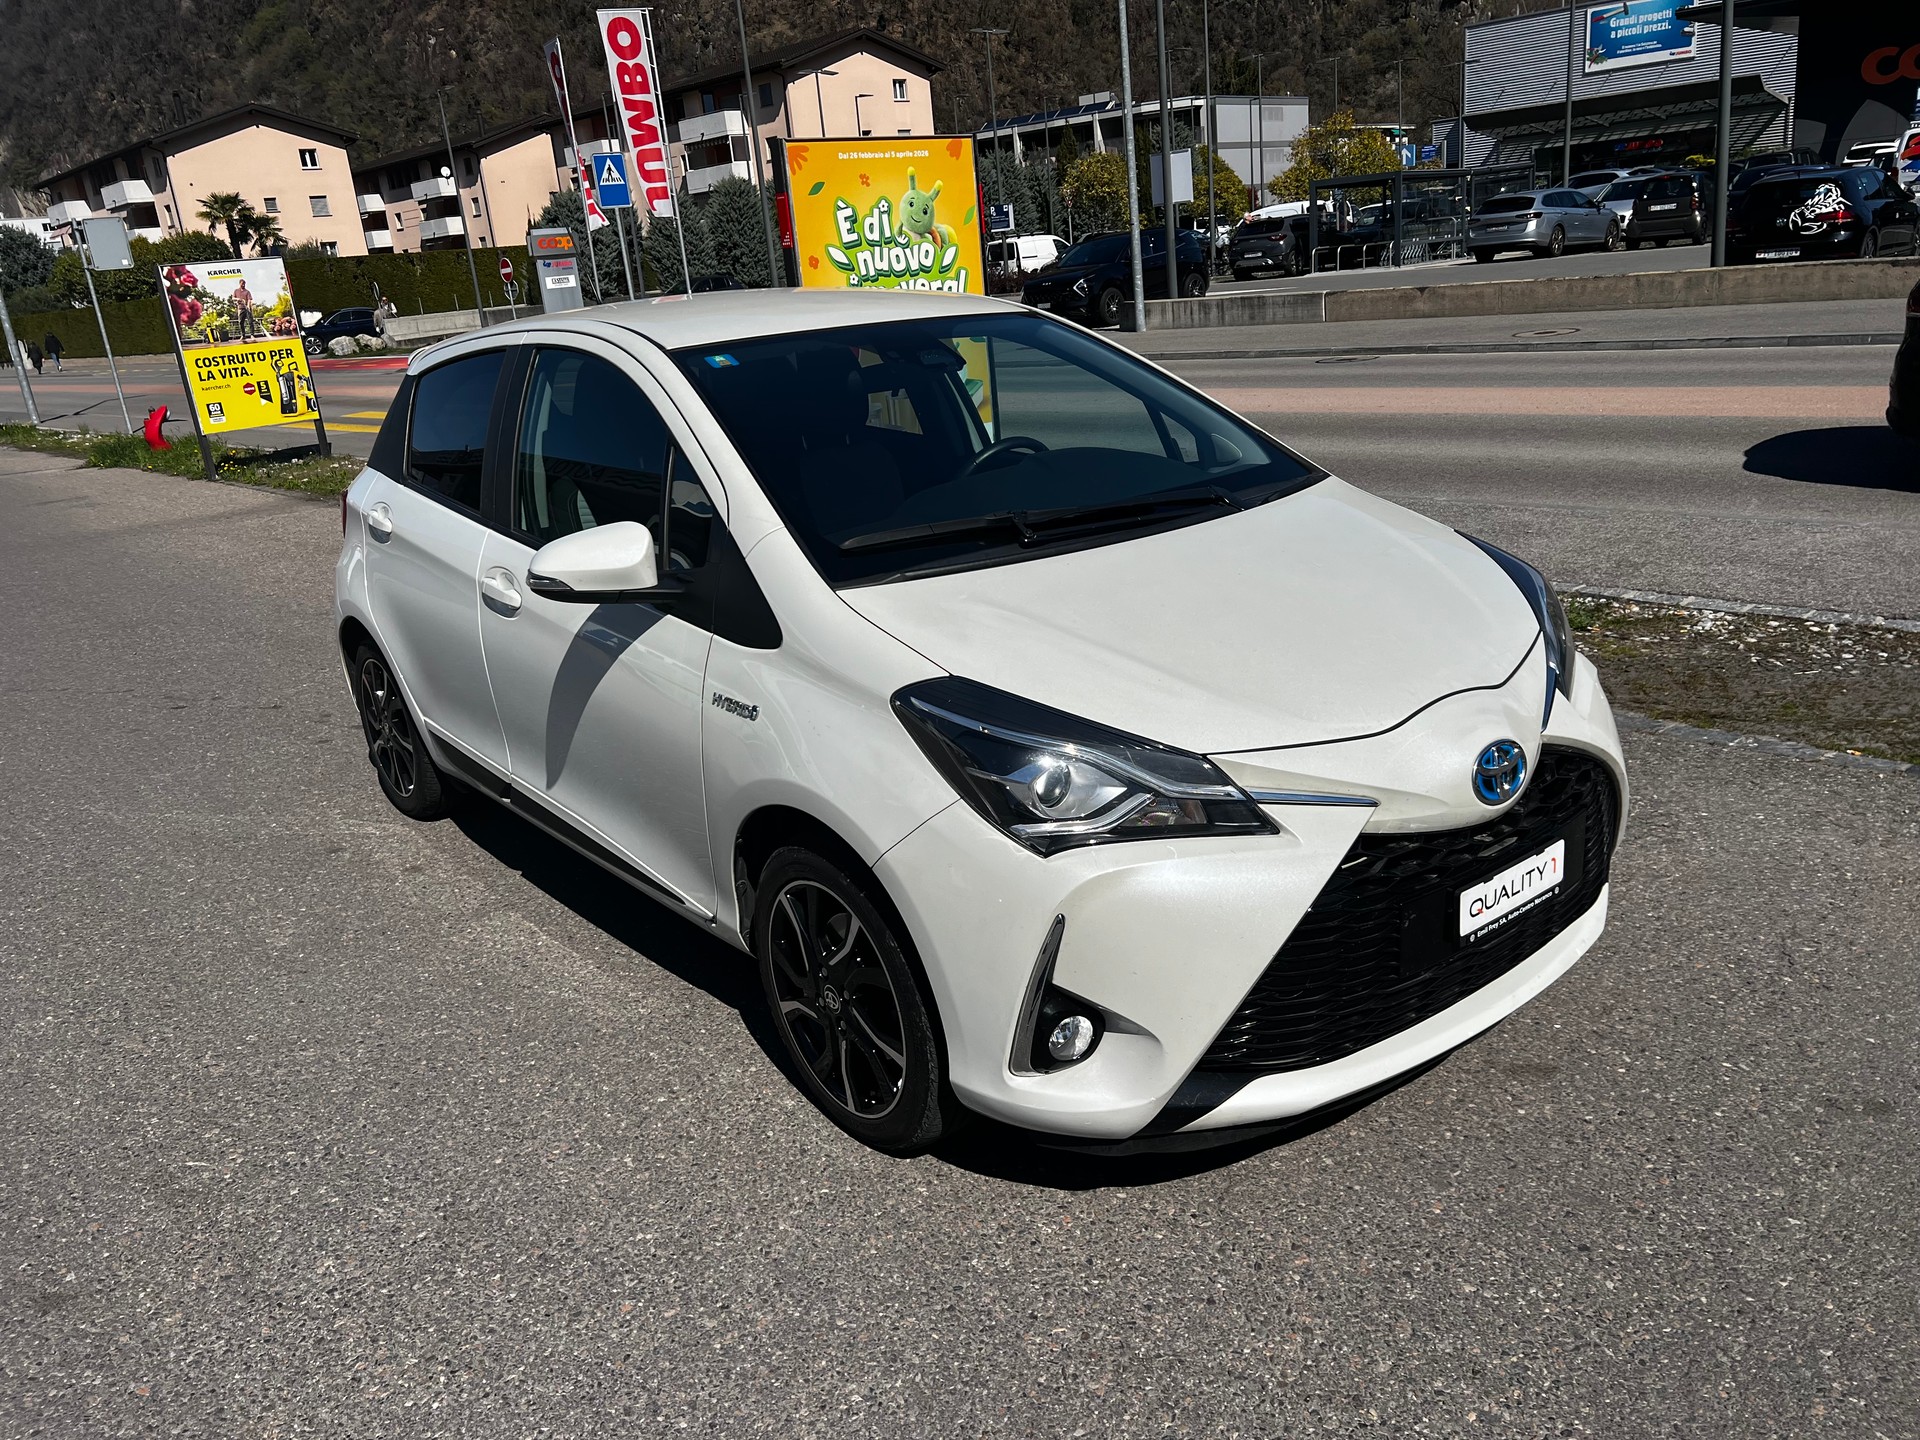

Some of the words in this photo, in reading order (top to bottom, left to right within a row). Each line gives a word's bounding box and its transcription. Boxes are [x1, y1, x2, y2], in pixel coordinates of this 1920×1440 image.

[1610, 14, 1638, 28] Grandi
[1640, 8, 1672, 23] progetti
[1610, 30, 1616, 39] a
[1617, 25, 1642, 38] piccoli
[1643, 20, 1672, 34] prezzi.
[606, 16, 670, 212] JUMBO
[838, 152, 849, 160] Dal
[849, 151, 858, 159] 26
[859, 150, 884, 159] febbraio
[884, 150, 890, 158] al
[896, 150, 913, 159] aprile
[913, 150, 929, 158] 2026
[836, 199, 858, 244] È
[863, 198, 892, 242] di
[537, 236, 574, 250] coop
[857, 242, 935, 277] nuovo
[195, 352, 266, 369] COSTRUITO
[269, 348, 295, 360] PER
[198, 369, 217, 382] LA
[218, 366, 254, 379] VITA.
[201, 384, 231, 392] kaercher.ch
[260, 382, 267, 390] 5
[208, 404, 221, 412] 60
[1470, 861, 1548, 918] QUALITY
[1551, 857, 1557, 874] 1
[1477, 927, 1489, 937] Emil
[1489, 921, 1500, 930] Frey
[1498, 917, 1507, 926] SA,
[1508, 902, 1534, 921] Auto-Centro
[1535, 891, 1553, 904] Noranco
